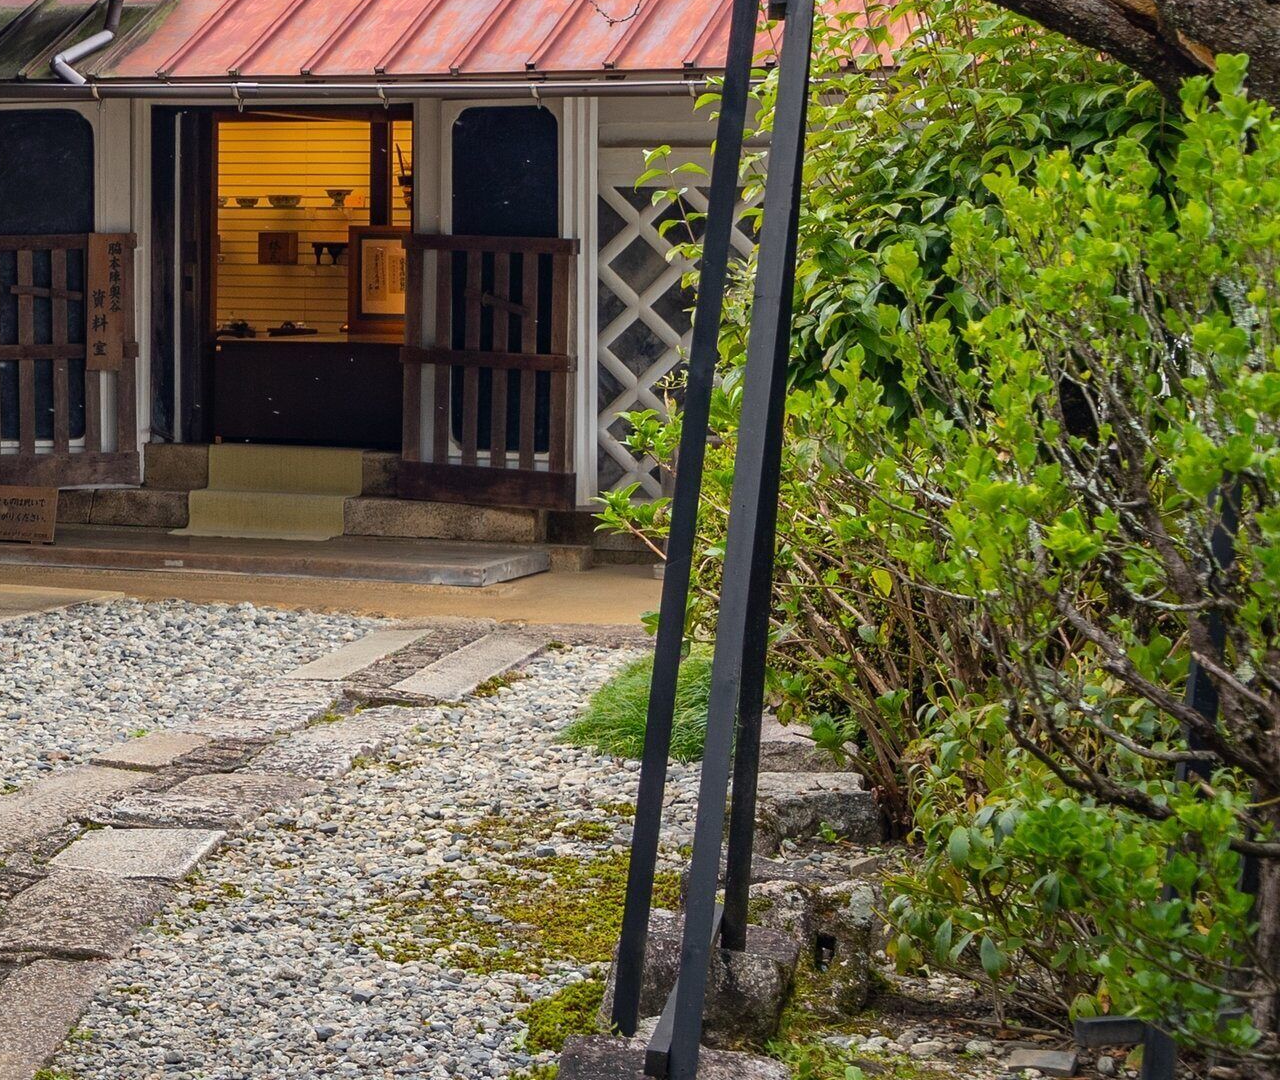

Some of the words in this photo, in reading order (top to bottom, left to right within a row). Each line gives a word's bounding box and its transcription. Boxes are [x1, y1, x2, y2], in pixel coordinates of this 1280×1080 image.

[108, 241, 122, 313] 脇本陣奥谷
[91, 289, 109, 357] 資料室
